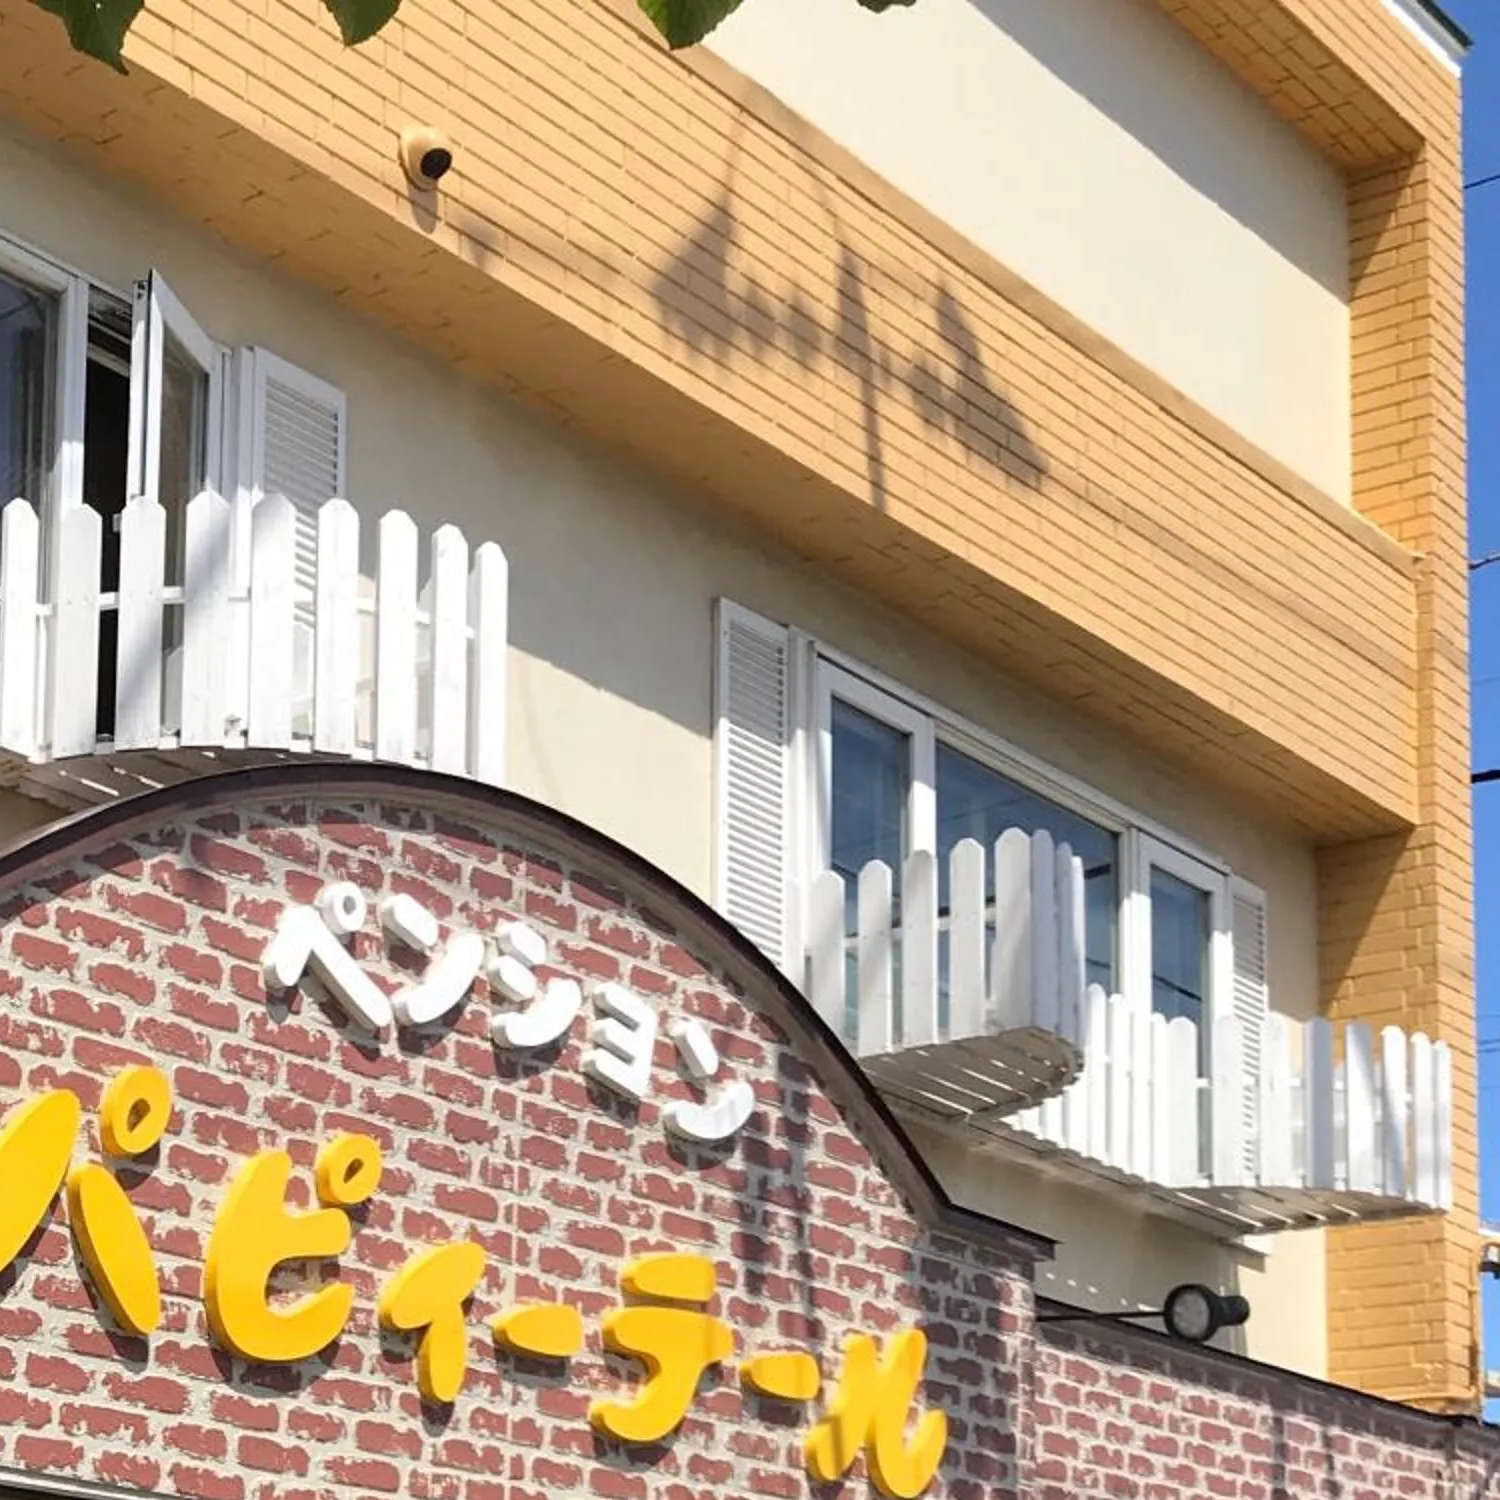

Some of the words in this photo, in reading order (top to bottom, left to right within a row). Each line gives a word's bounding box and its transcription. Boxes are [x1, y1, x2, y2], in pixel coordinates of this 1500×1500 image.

[263, 880, 755, 1141] ペンション
